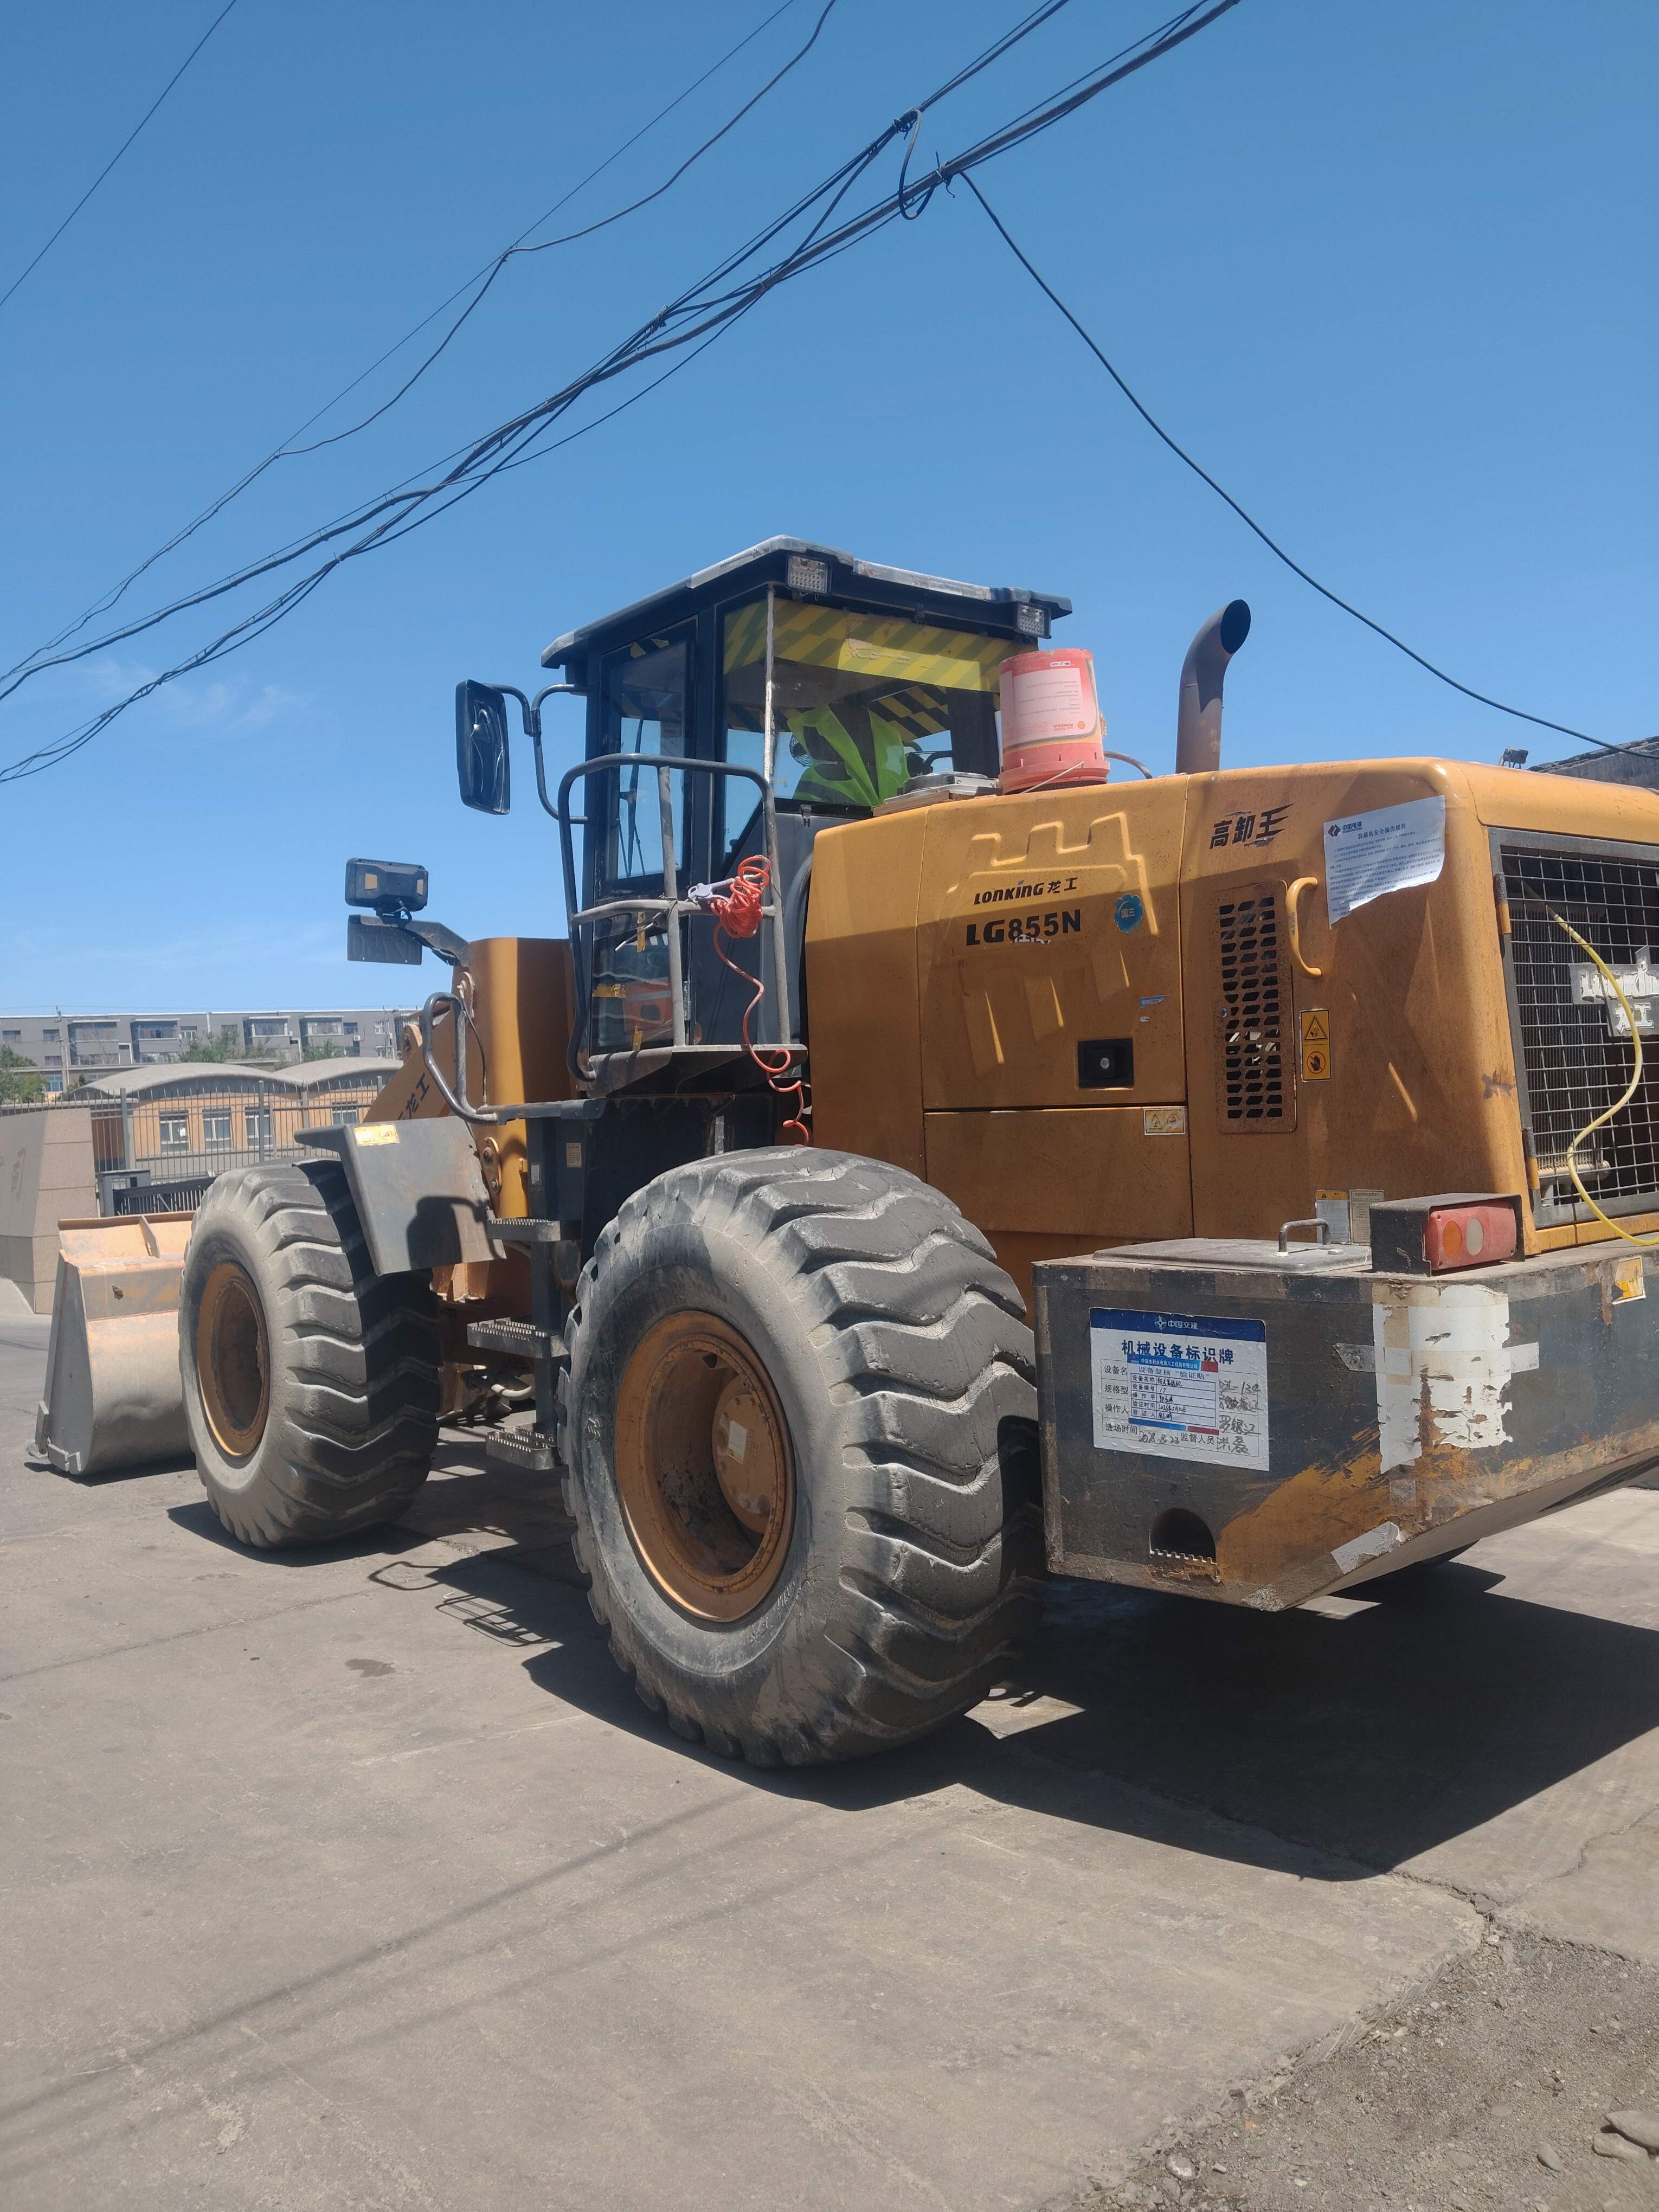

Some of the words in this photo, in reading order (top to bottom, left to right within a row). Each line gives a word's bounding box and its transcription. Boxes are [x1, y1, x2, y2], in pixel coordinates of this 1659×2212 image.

[1210, 803, 1294, 849] 高卸王
[1047, 877, 1078, 893] 龙工
[966, 909, 1081, 946] LG855N
[1167, 1320, 1198, 1330] 中国交建
[1121, 1339, 1234, 1365] 机械设备标识牌
[1132, 1375, 1155, 1383] 设备名称
[1133, 1383, 1155, 1392] 设备编号
[1133, 1401, 1155, 1409] 验证时间
[1105, 1423, 1137, 1435] 进场时间
[1181, 1432, 1214, 1445] 监督人员
